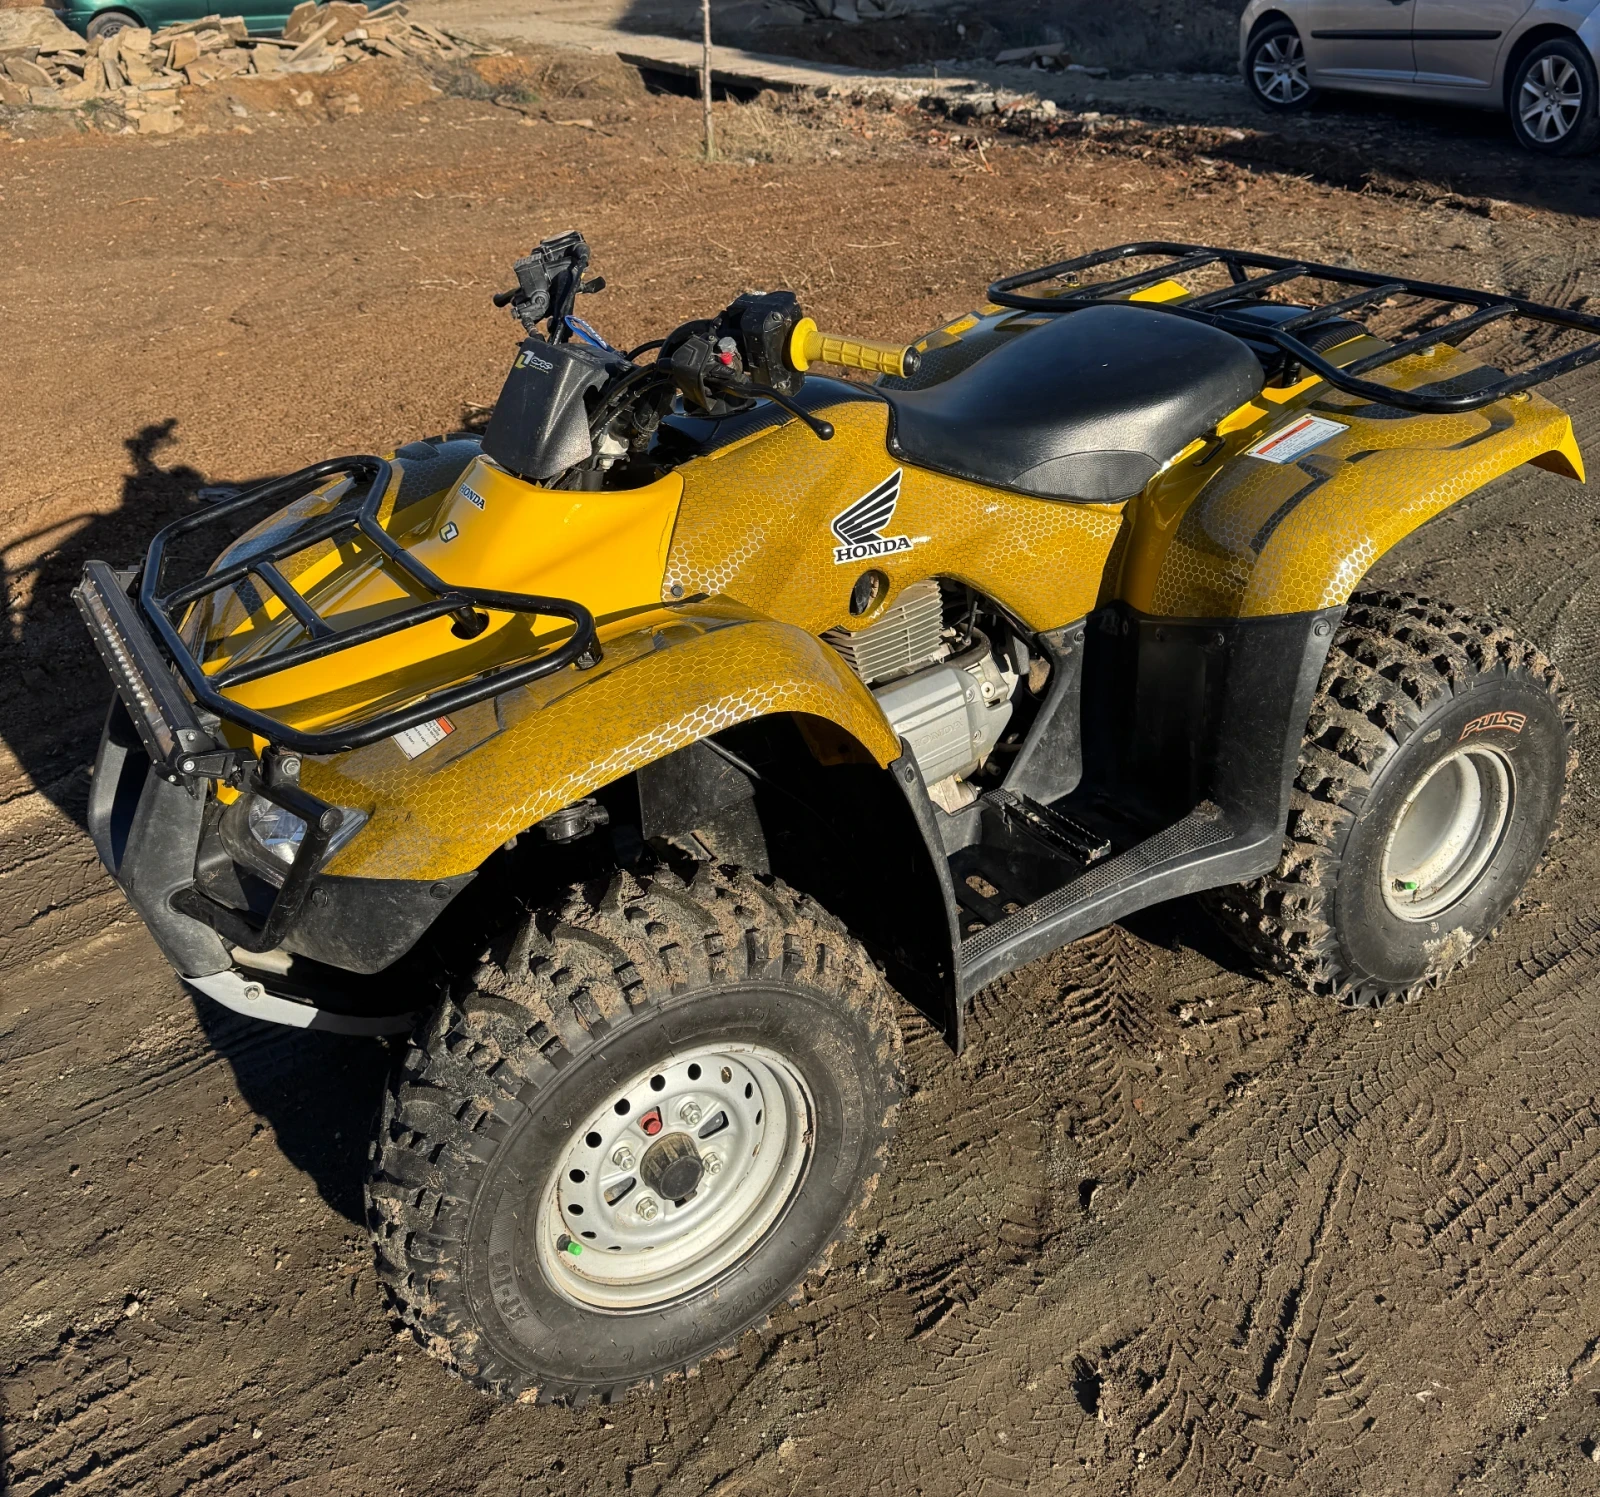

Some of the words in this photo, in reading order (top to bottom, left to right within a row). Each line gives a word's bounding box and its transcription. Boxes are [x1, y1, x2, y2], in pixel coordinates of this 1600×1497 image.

[460, 484, 486, 510] HONDA
[835, 537, 912, 562] HONDA
[1458, 711, 1527, 743] PULSE
